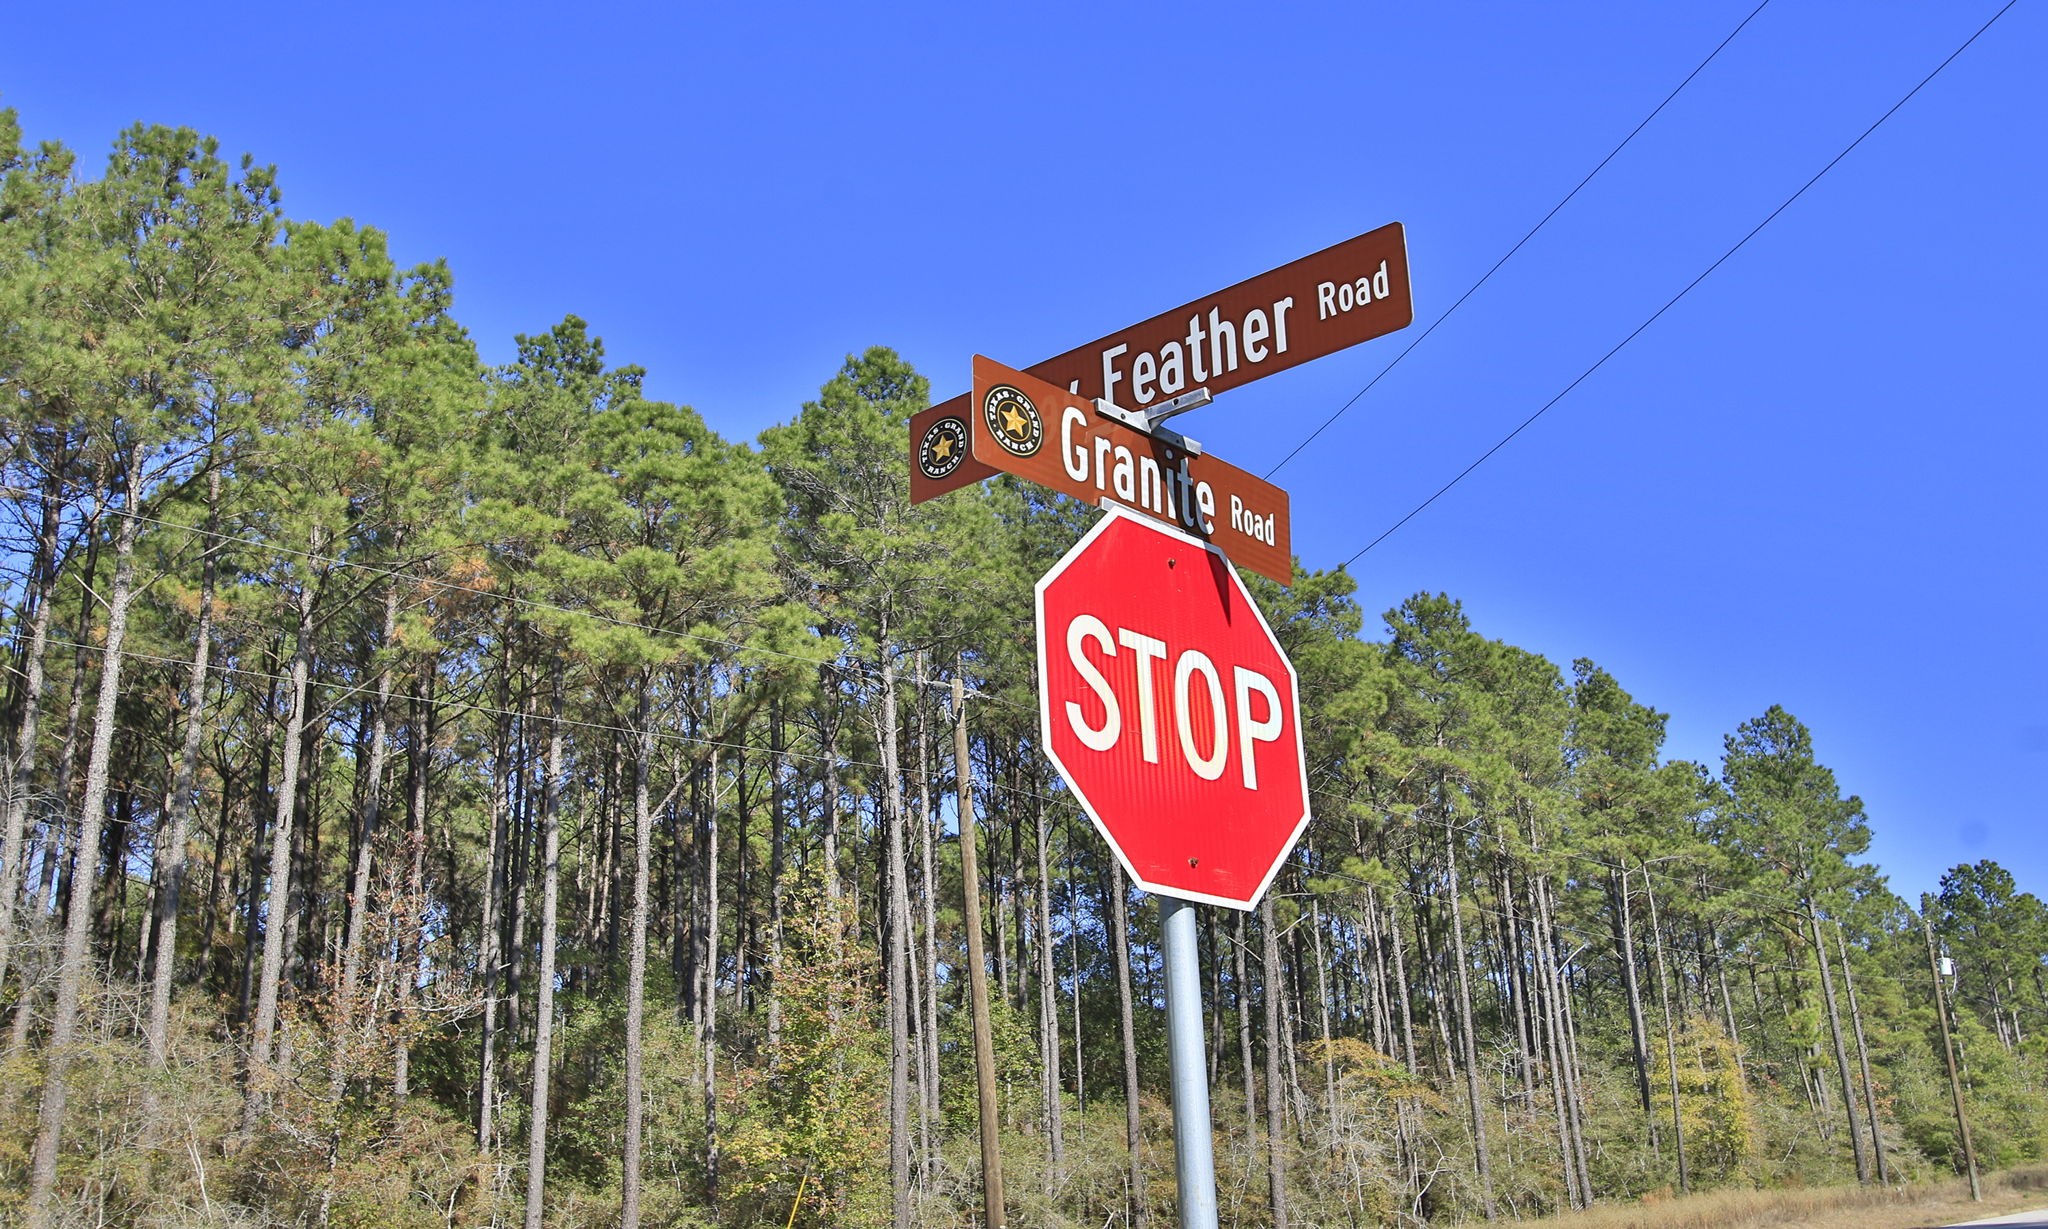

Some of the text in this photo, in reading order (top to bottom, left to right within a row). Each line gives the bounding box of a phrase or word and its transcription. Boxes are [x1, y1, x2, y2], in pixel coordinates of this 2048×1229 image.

[1102, 259, 1389, 406] Feather Road
[989, 390, 1040, 437] TEXAS GRAND
[922, 422, 964, 463] TEXAS GRAND
[996, 429, 1034, 451] RANCH
[927, 455, 959, 475] RANCH
[1061, 406, 1275, 547] Granite Road
[1065, 614, 1283, 791] STOP
